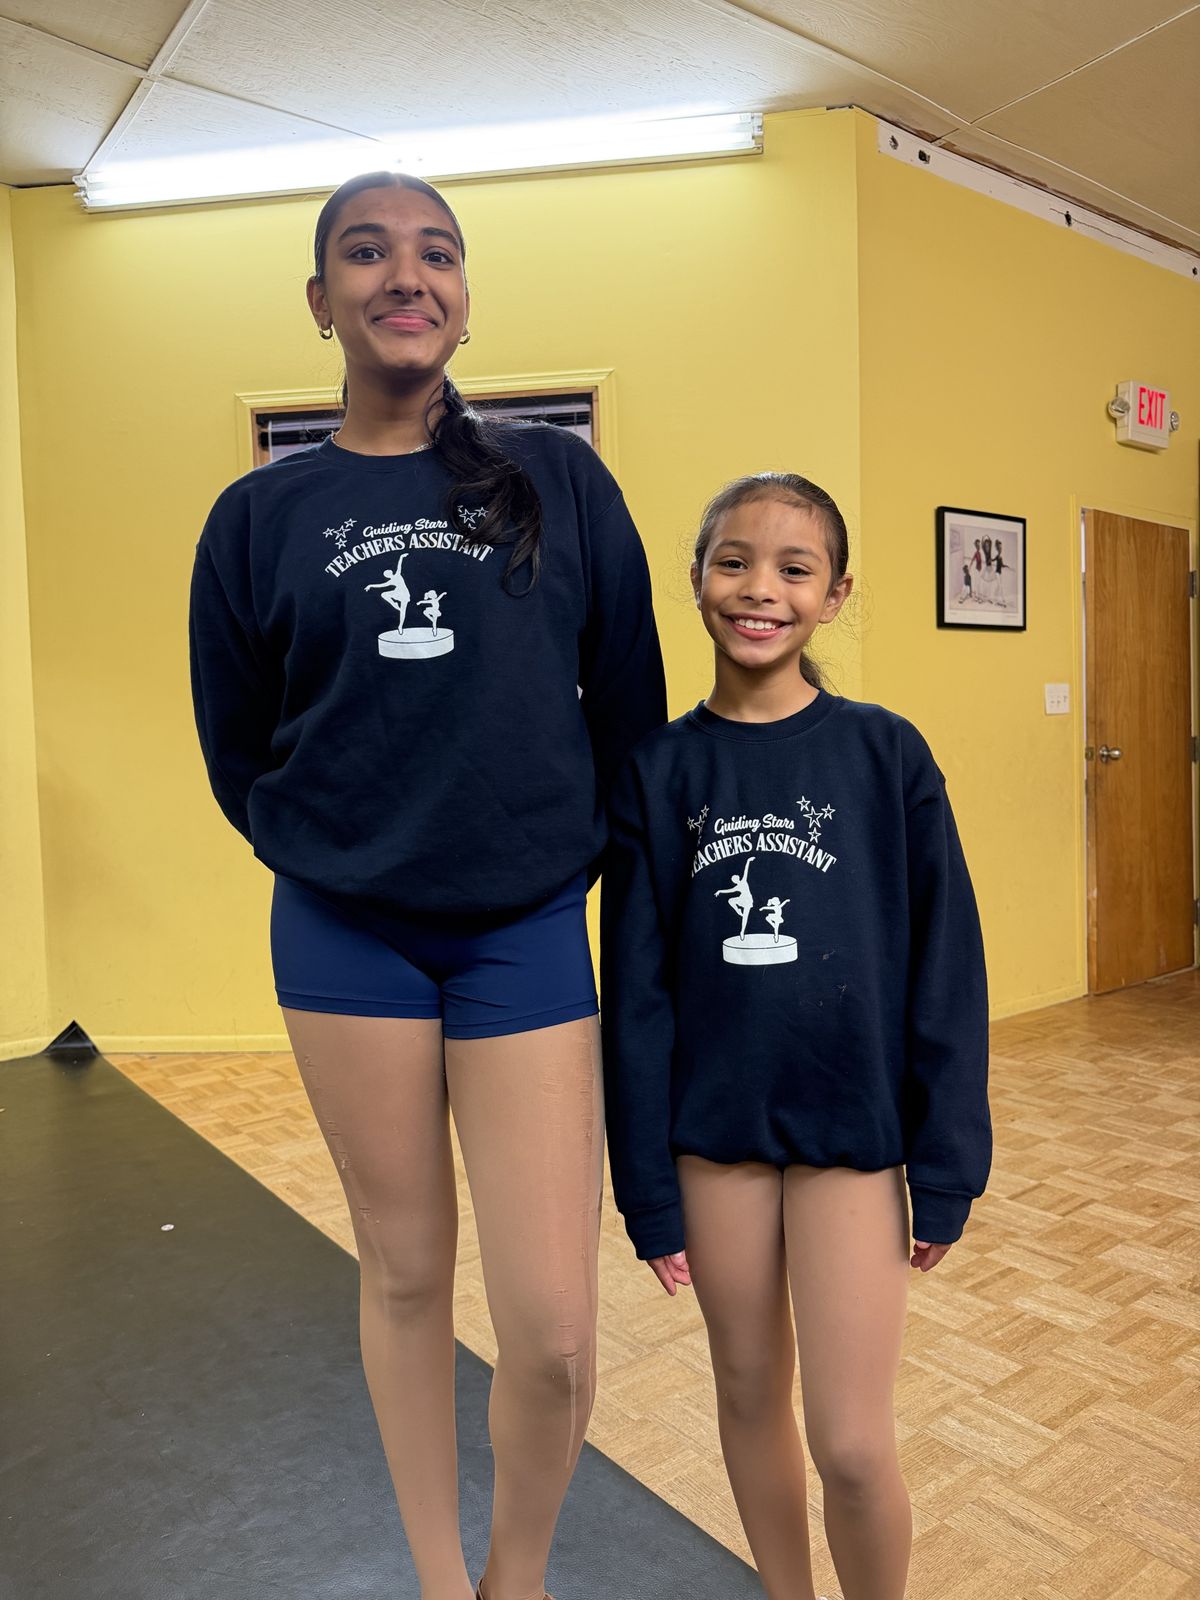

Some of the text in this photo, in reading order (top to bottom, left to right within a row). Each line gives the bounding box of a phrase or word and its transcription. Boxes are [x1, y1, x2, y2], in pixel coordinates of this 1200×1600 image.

[1138, 386, 1166, 430] EXIT
[362, 518, 448, 538] Guiding Stars
[324, 532, 494, 578] TEACHERS ASSISTANT
[714, 813, 795, 835] Guiding Stars
[691, 832, 838, 878] EACHERS ASSISTANT
